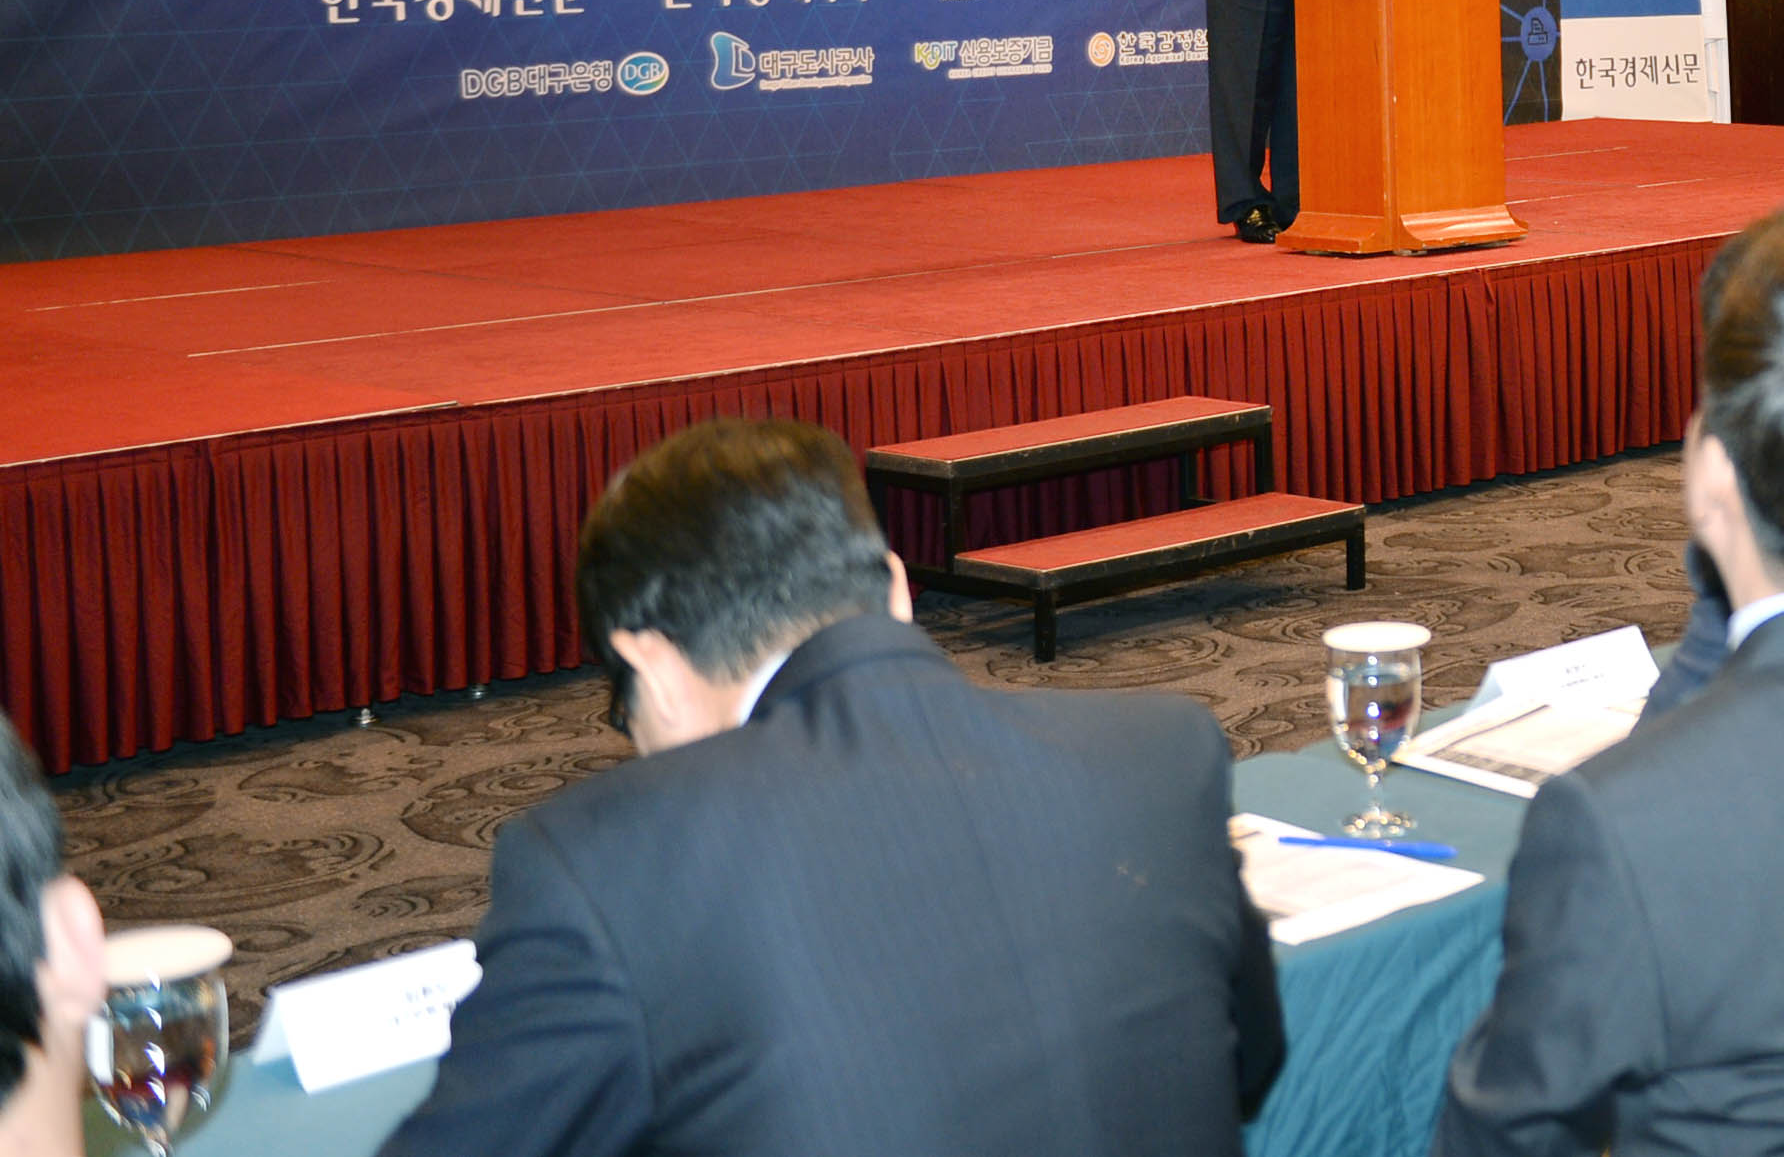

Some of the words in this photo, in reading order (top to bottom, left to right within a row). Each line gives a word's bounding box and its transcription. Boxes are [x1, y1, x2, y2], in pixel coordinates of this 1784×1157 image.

[960, 36, 1053, 66] 신용보증기금
[1117, 29, 1208, 55] 한국감정원
[624, 61, 662, 81] DGB
[759, 46, 875, 79] 대구도시공사
[1576, 54, 1701, 89] 한국경제신문
[461, 61, 613, 99] DGB대구은행
